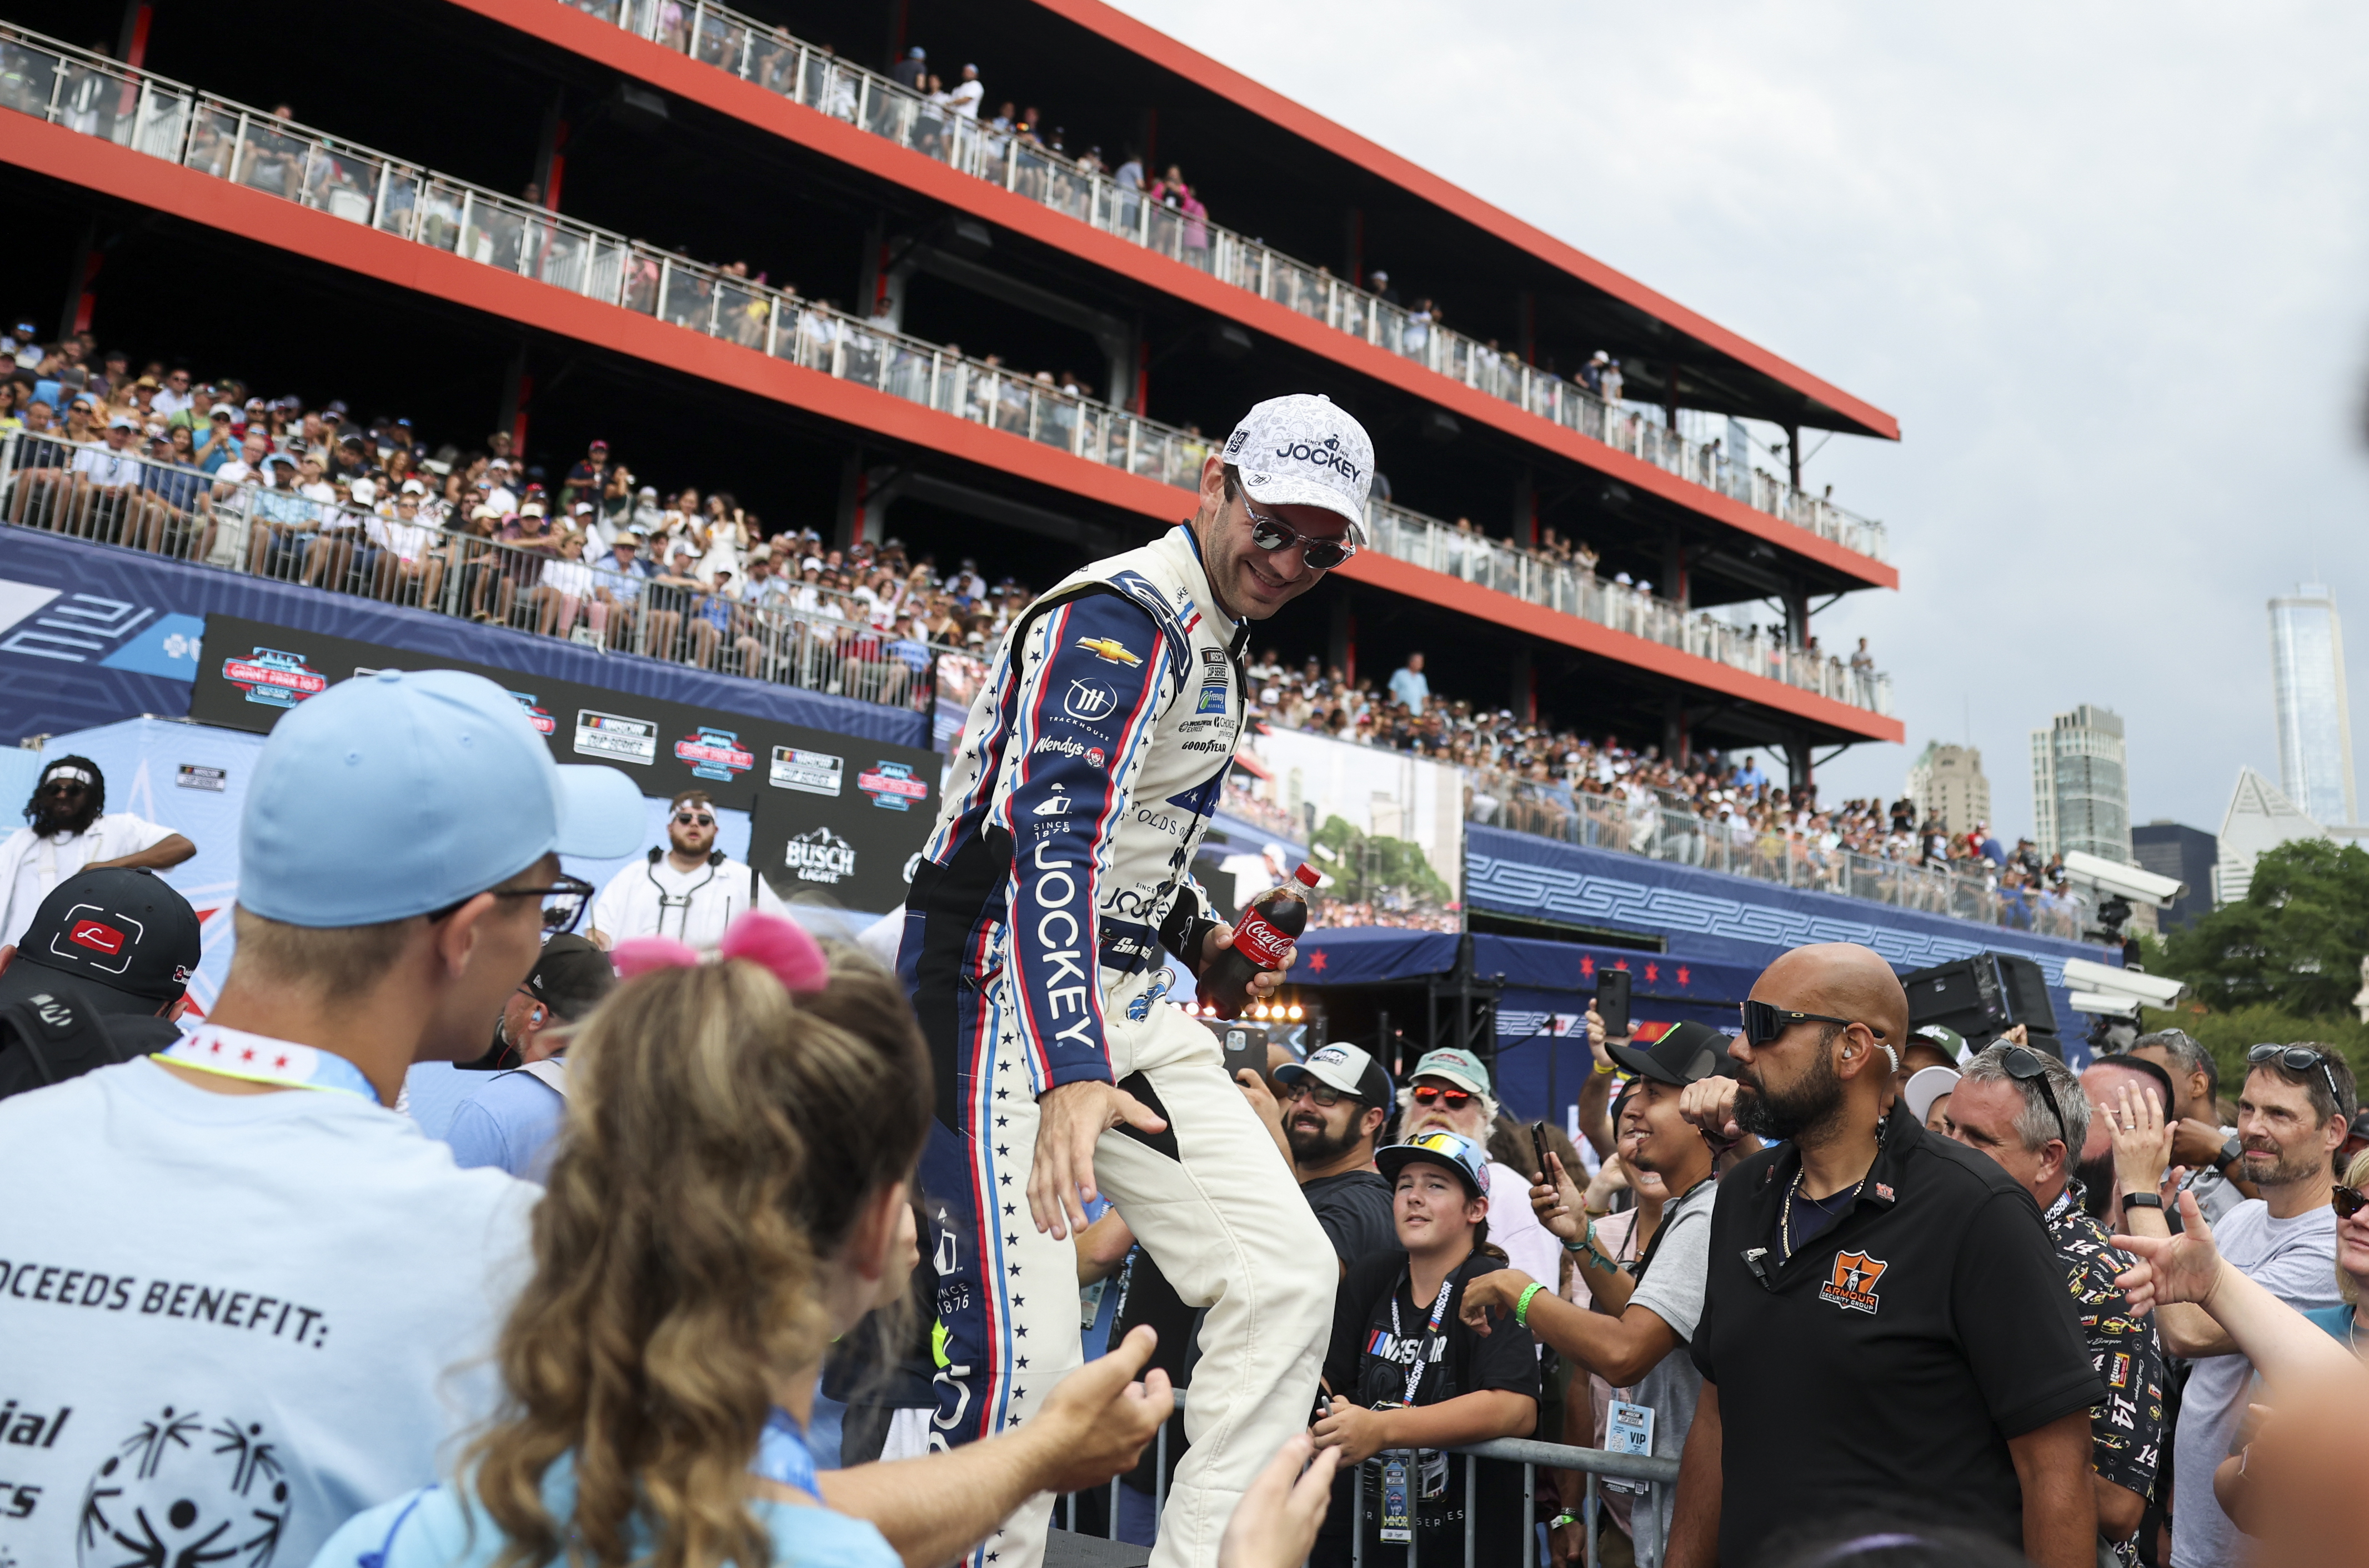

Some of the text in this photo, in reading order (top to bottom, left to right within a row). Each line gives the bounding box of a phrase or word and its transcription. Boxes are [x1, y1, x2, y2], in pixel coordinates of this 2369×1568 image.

[1276, 443, 1361, 483] JOCKEY
[1210, 652, 1224, 663] NASCAR
[1215, 667, 1226, 677] SERIES
[1209, 690, 1225, 704] Freeway
[1049, 717, 1110, 742] TRACKHOUSE
[1220, 717, 1235, 729] CHOICE
[1034, 735, 1084, 758] Wendy's
[1181, 739, 1226, 754] GOODYEAR
[1034, 821, 1070, 830] SINCE
[1034, 827, 1070, 840] 1876
[785, 840, 857, 876] BUSCH
[1135, 882, 1155, 894] SINCE
[1233, 919, 1250, 940] RECYCLE
[1035, 840, 1095, 1049] JOCKEY
[1252, 941, 1270, 954] ORIGINAL
[2044, 1194, 2070, 1223] NASCA
[2063, 1239, 2100, 1256] 14
[937, 1283, 968, 1299] INCE
[1825, 1285, 1875, 1306] ARMOUR
[937, 1294, 969, 1315] 1876
[1431, 1281, 1453, 1321] NASCAR
[1822, 1292, 1874, 1310] SECURITY GROUP
[140, 1280, 329, 1349] BENEFIT:
[2092, 1354, 2105, 1371] 4
[2110, 1356, 2121, 1382] RUSH
[1405, 1359, 1426, 1399] NASCAR
[2111, 1393, 2137, 1430] 14
[1630, 1431, 1646, 1445] VIP
[2135, 1444, 2158, 1468] 14
[1390, 1505, 1403, 1516] VIP
[1384, 1515, 1408, 1527] MINOR
